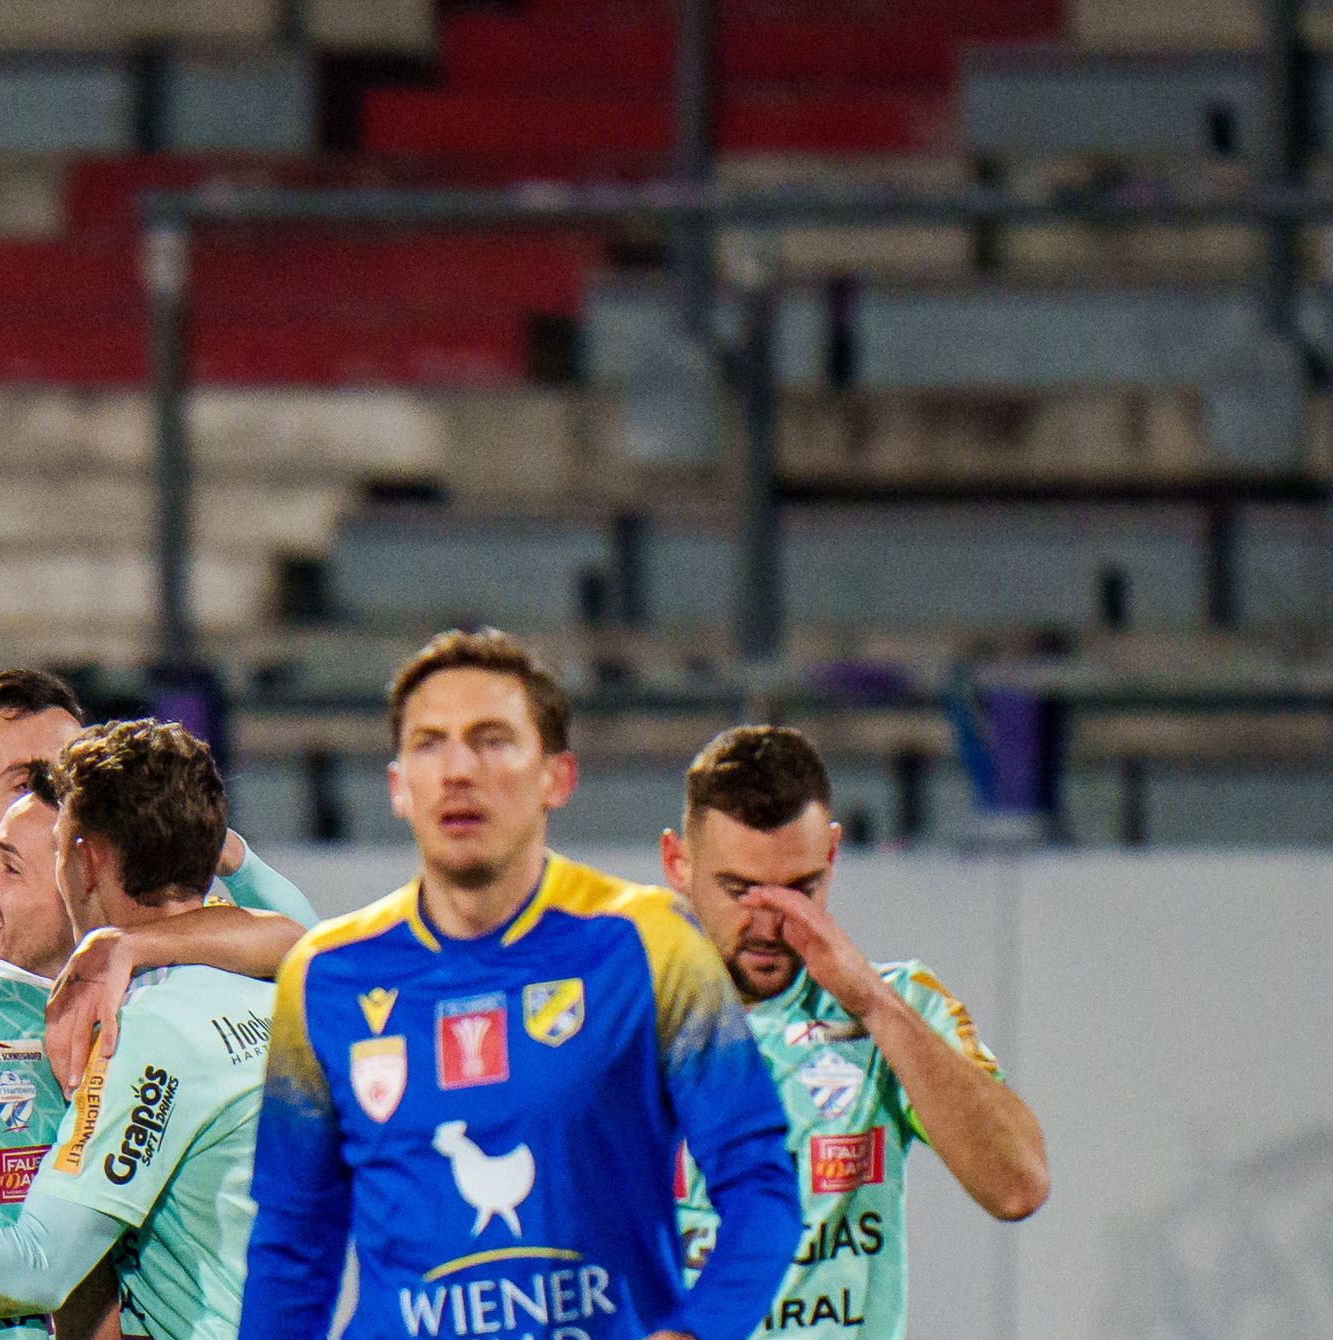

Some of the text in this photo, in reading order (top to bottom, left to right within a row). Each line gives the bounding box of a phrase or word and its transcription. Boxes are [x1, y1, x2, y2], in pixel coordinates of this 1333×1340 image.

[141, 1076, 179, 1168] SOFT DRINKS
[399, 1263, 618, 1338] WIENER
